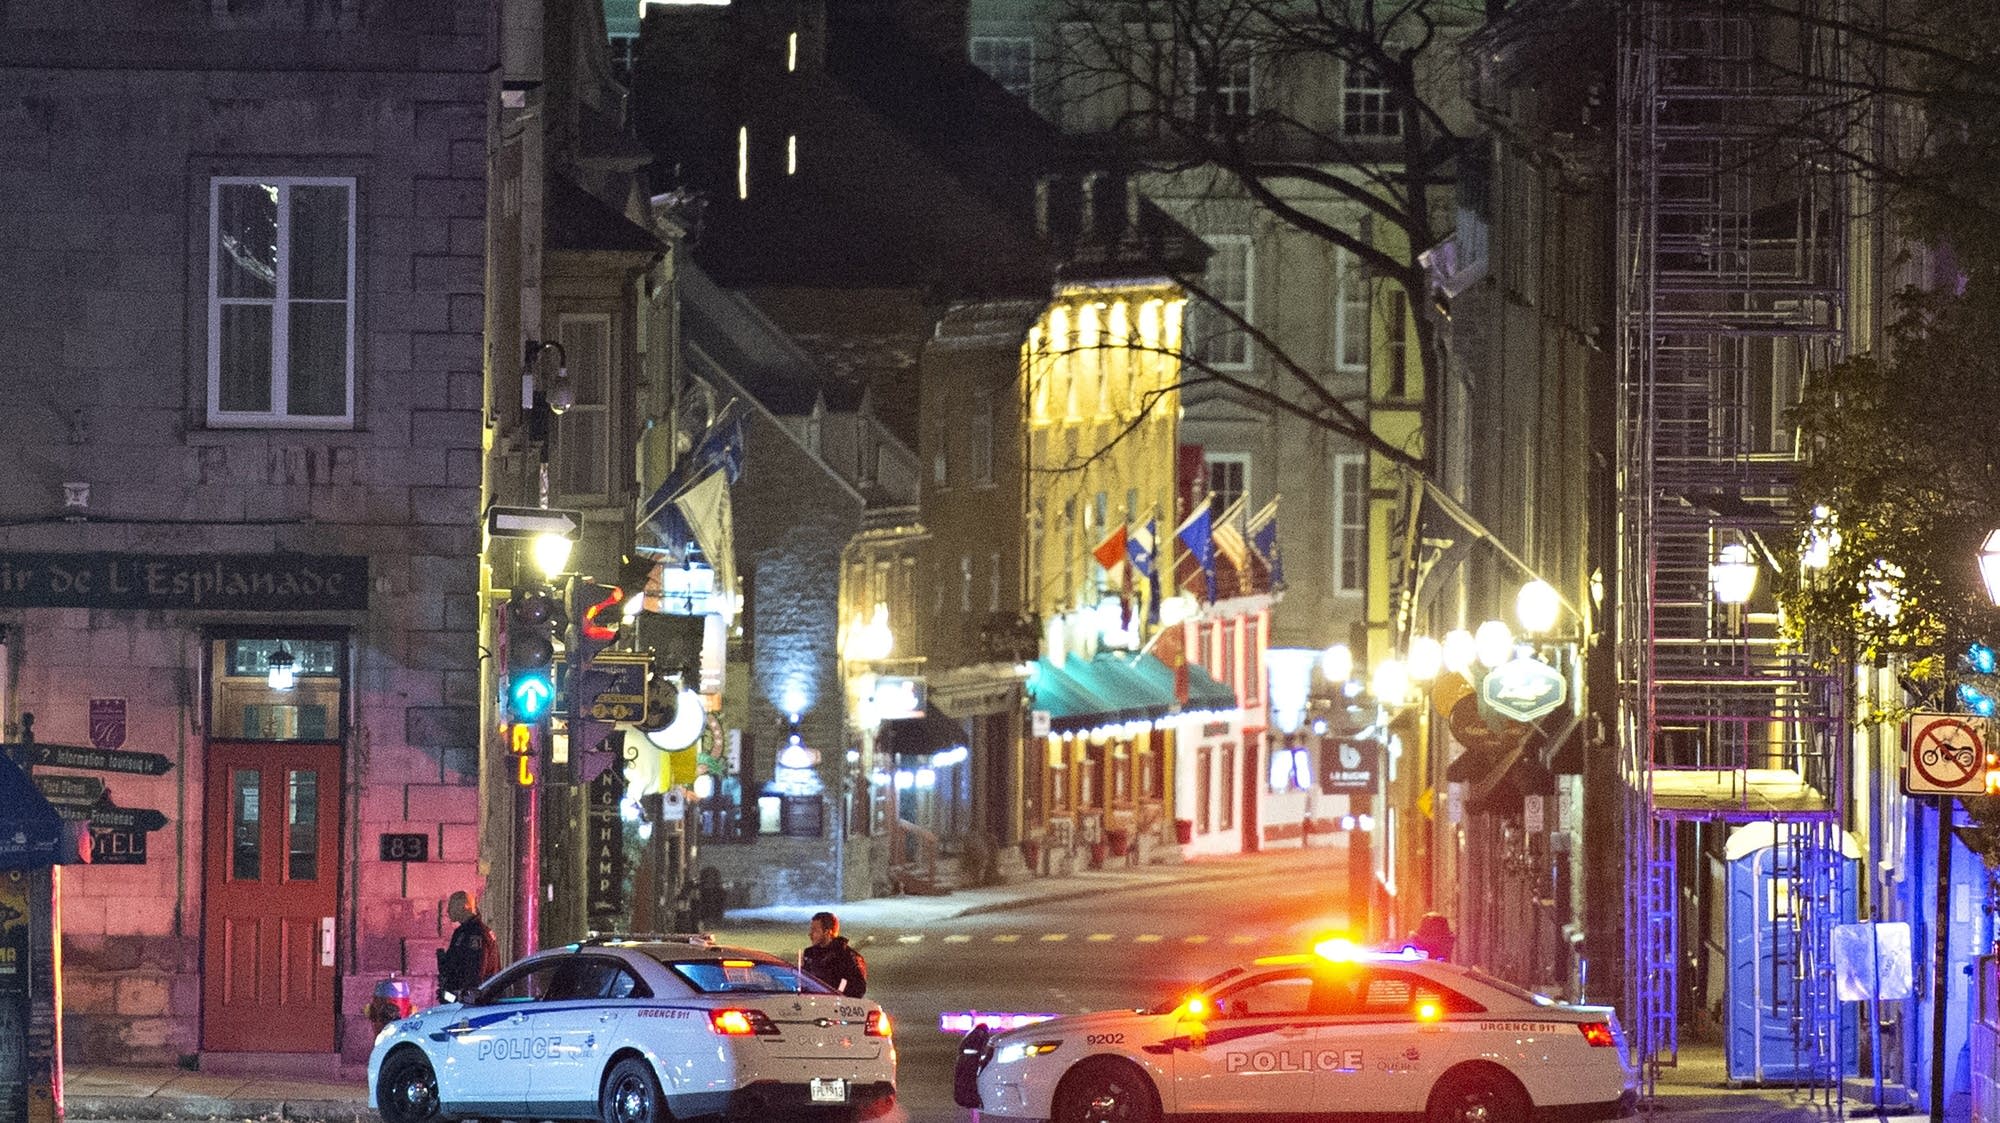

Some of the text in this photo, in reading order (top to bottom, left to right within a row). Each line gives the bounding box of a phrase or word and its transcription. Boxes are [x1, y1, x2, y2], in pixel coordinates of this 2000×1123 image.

[57, 749, 105, 766] Information
[599, 738, 613, 892] LNGCHAMP
[91, 832, 144, 855] TEL
[391, 837, 421, 858] 83
[637, 1009, 690, 1019] URGENCE 911
[839, 1005, 865, 1017] 9240
[1480, 1022, 1556, 1033] URGENCE 911
[478, 1036, 561, 1061] POLICE
[1087, 1033, 1124, 1045] 9202
[1226, 1050, 1363, 1073] POLICE
